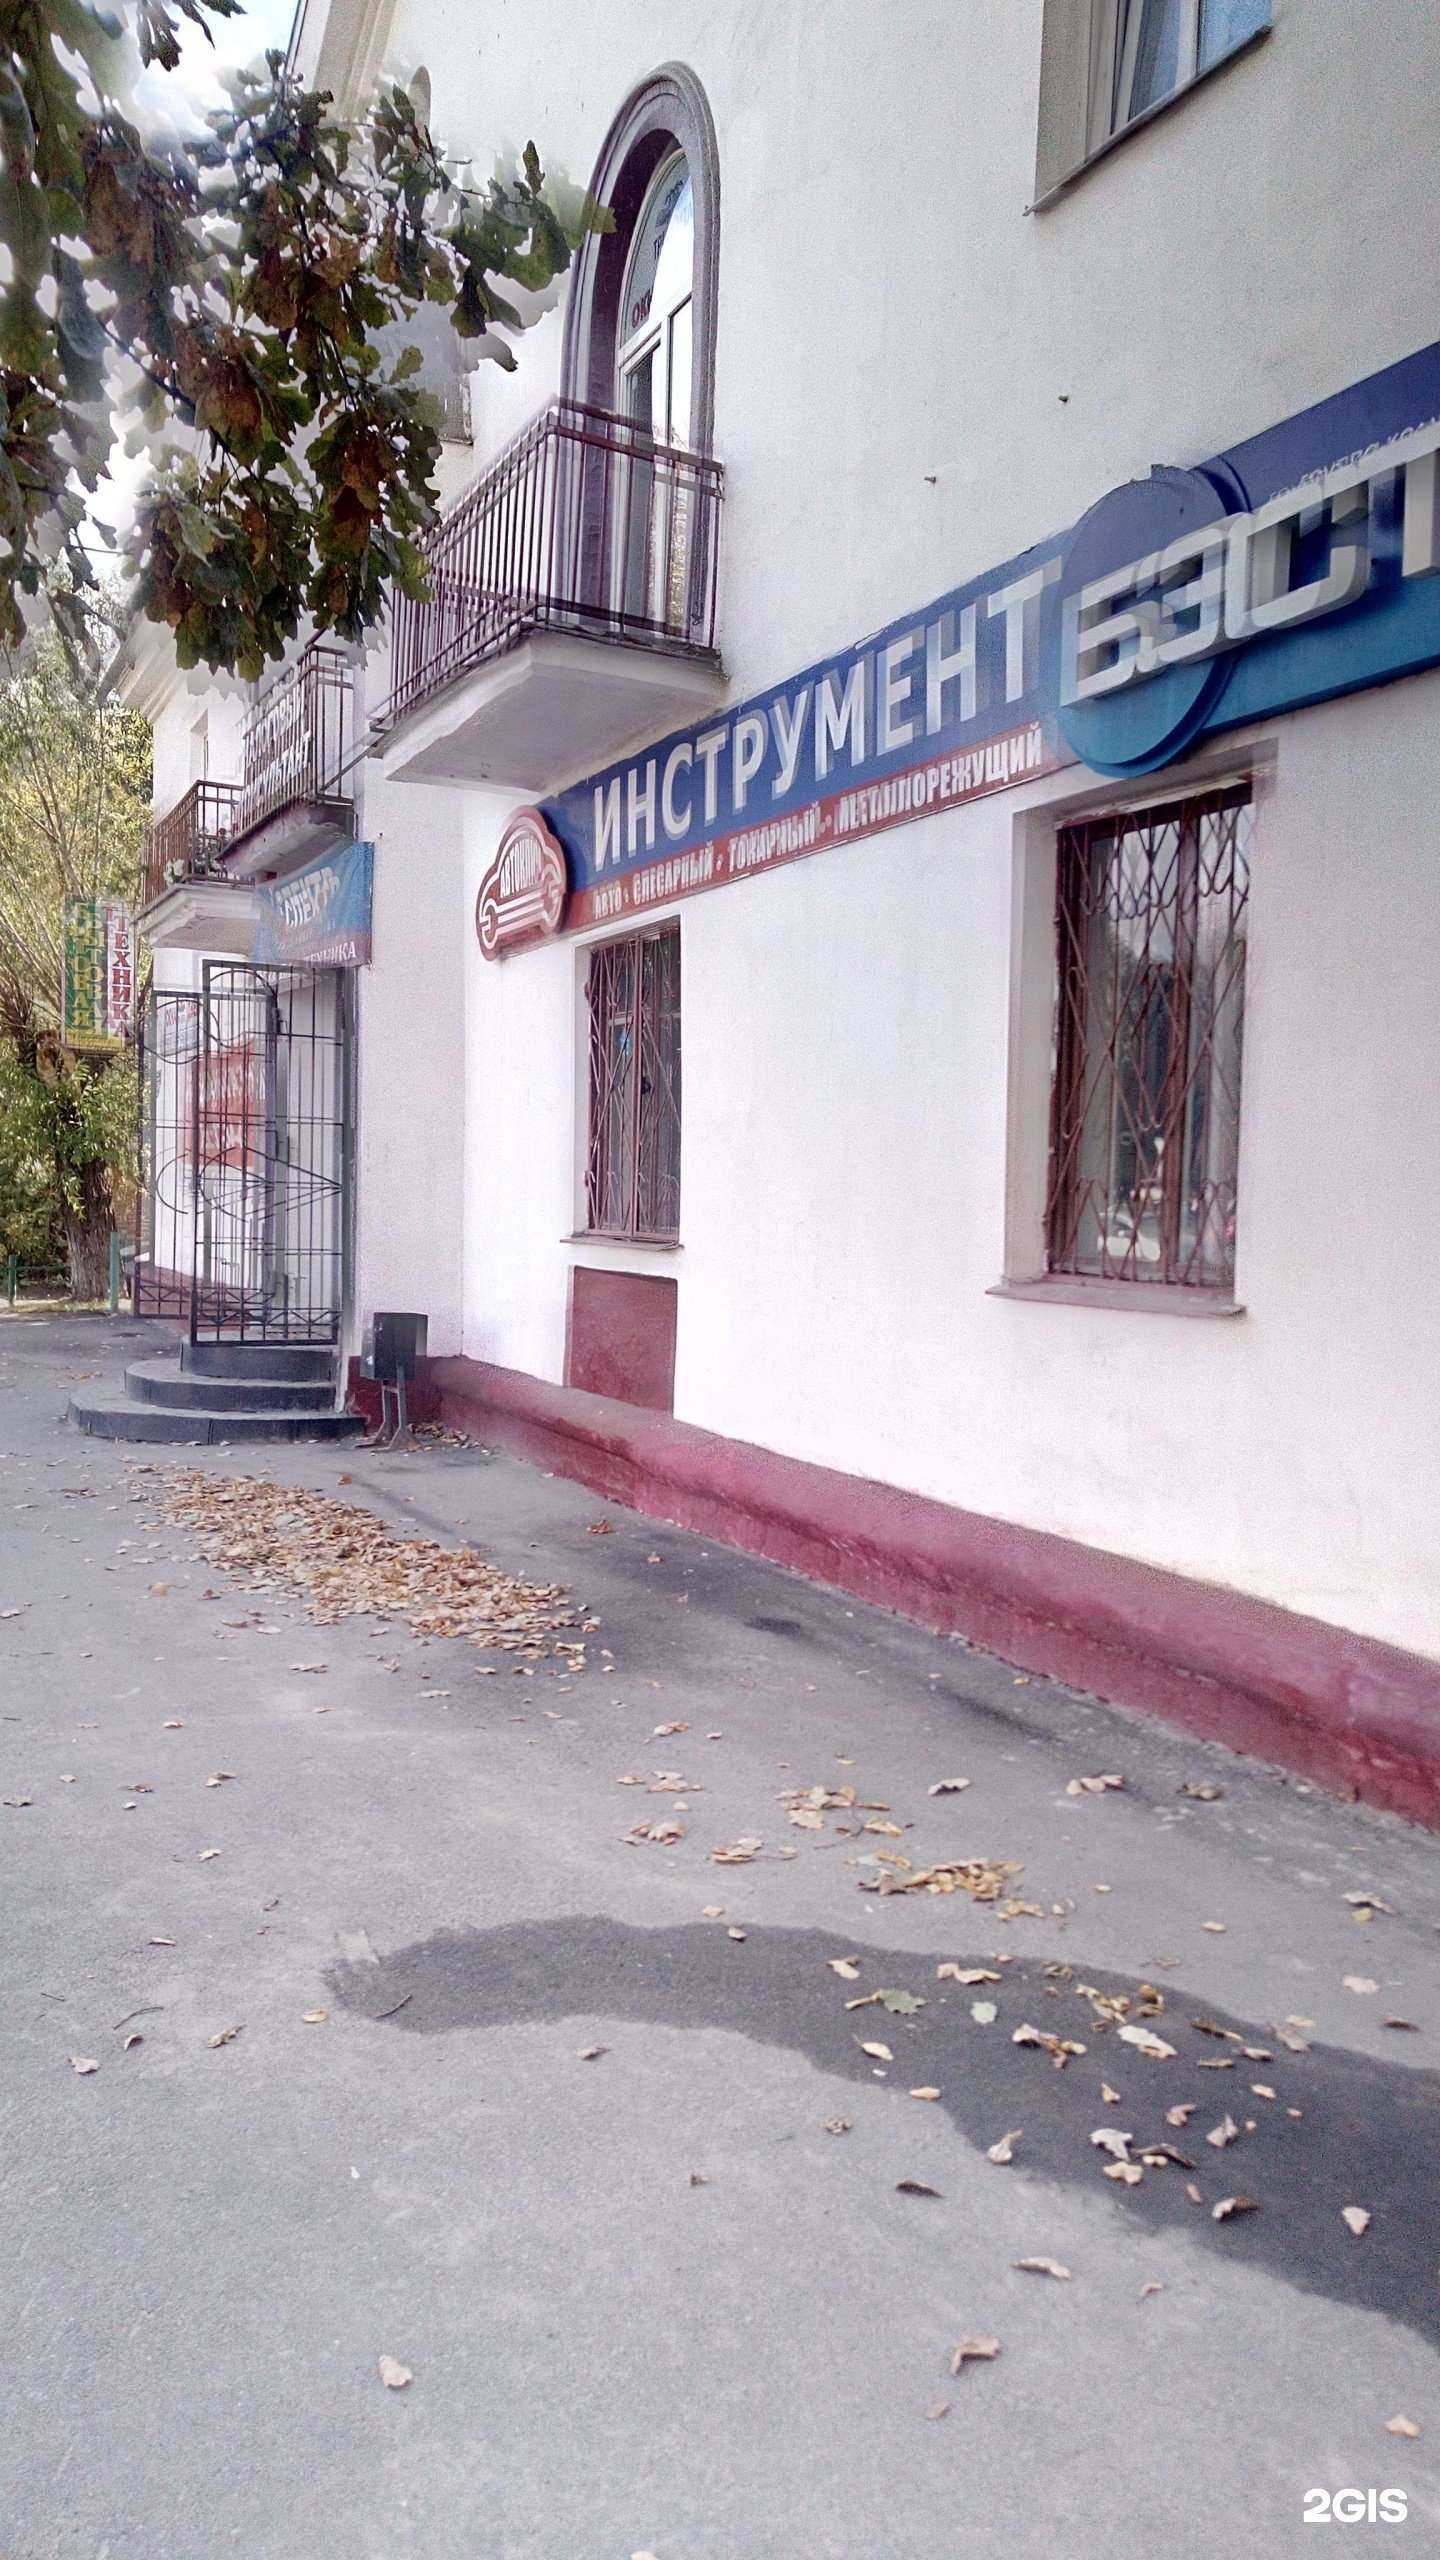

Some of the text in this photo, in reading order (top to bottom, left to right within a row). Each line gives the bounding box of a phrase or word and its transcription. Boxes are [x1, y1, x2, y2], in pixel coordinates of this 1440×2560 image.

[593, 556, 1061, 872] ИНСТРУМЕНТ
[593, 720, 1042, 920] АВТО СЛЕСАРНЫЙ ТОКАРНЫЙ МЕТАЛЛОРЕЖУЩИЙ
[106, 908, 131, 1038] ТЕХНИКА
